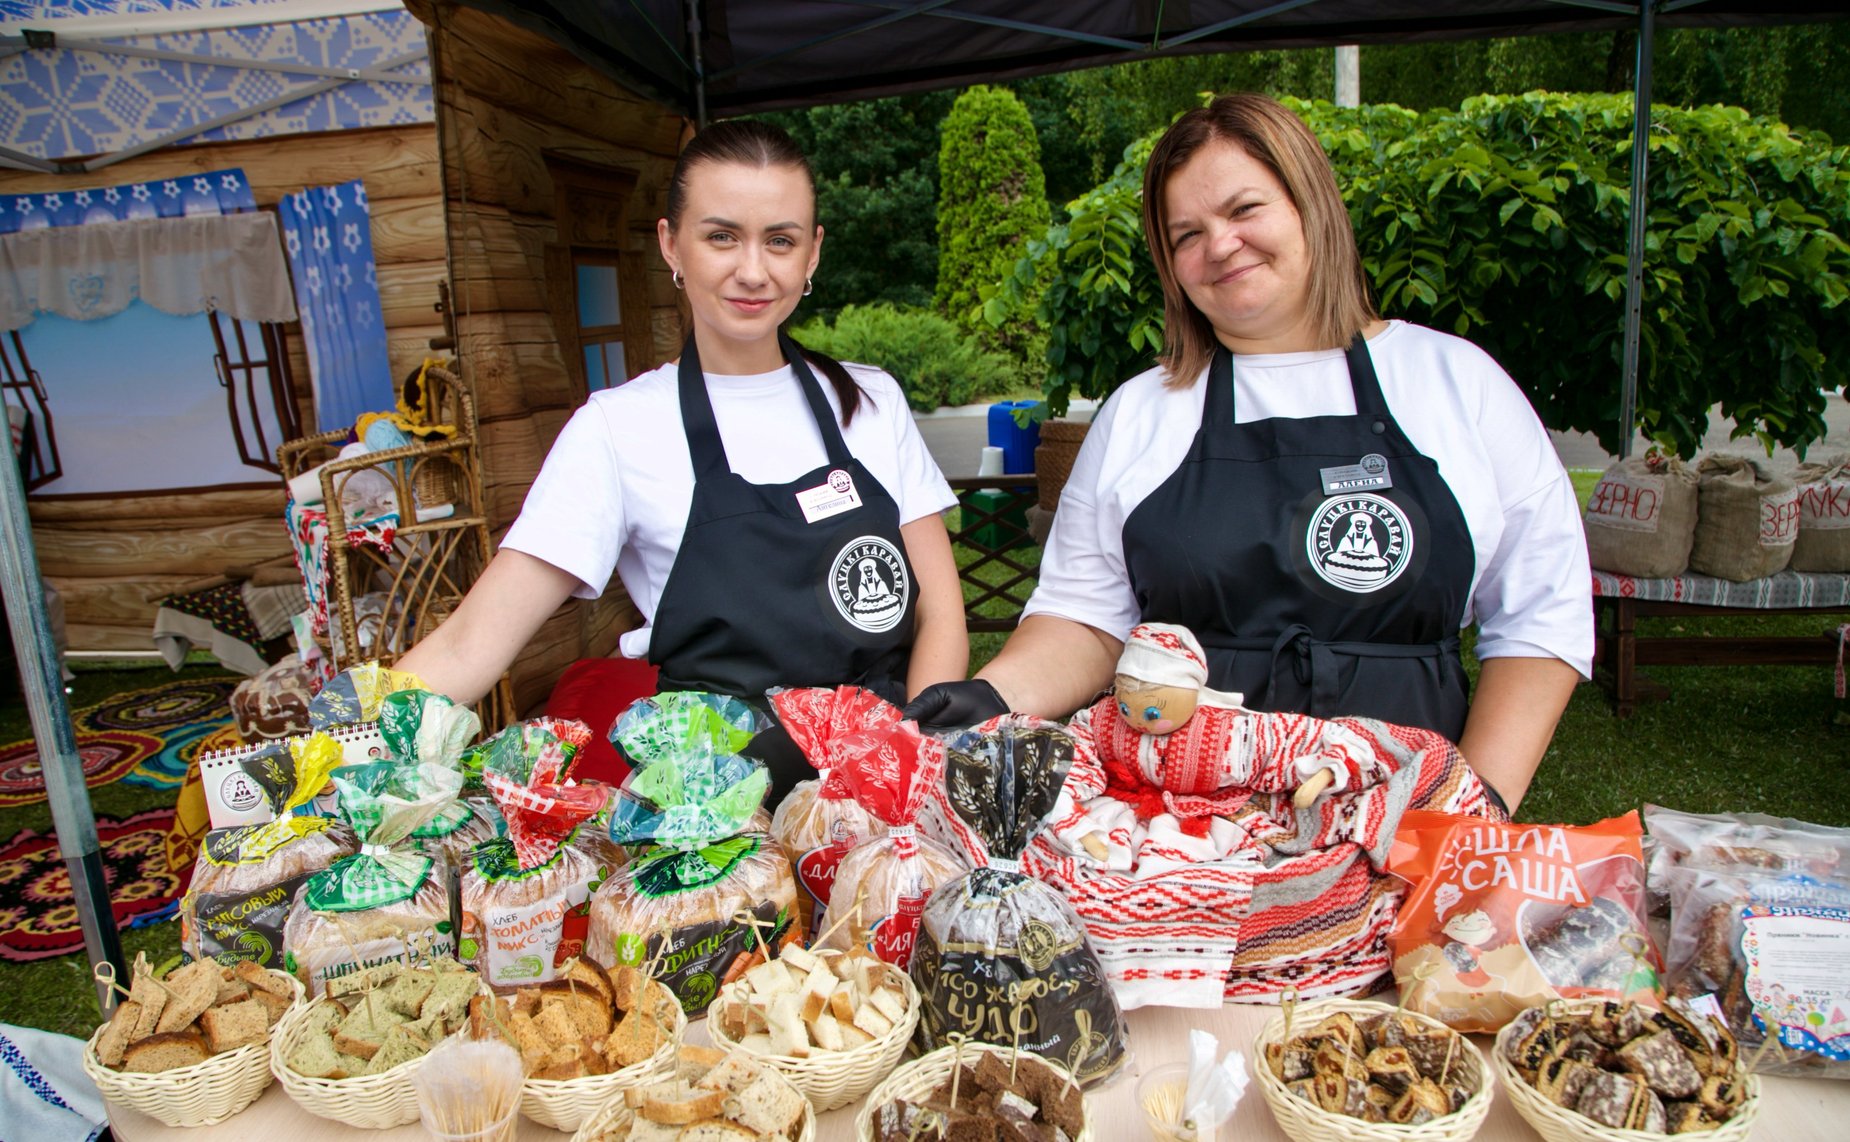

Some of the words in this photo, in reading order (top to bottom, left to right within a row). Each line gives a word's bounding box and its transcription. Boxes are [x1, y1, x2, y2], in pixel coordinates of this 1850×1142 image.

[1462, 855, 1586, 903] САША
[493, 913, 518, 926] ХЛЕБ
[948, 993, 1038, 1042] ЧУДО
